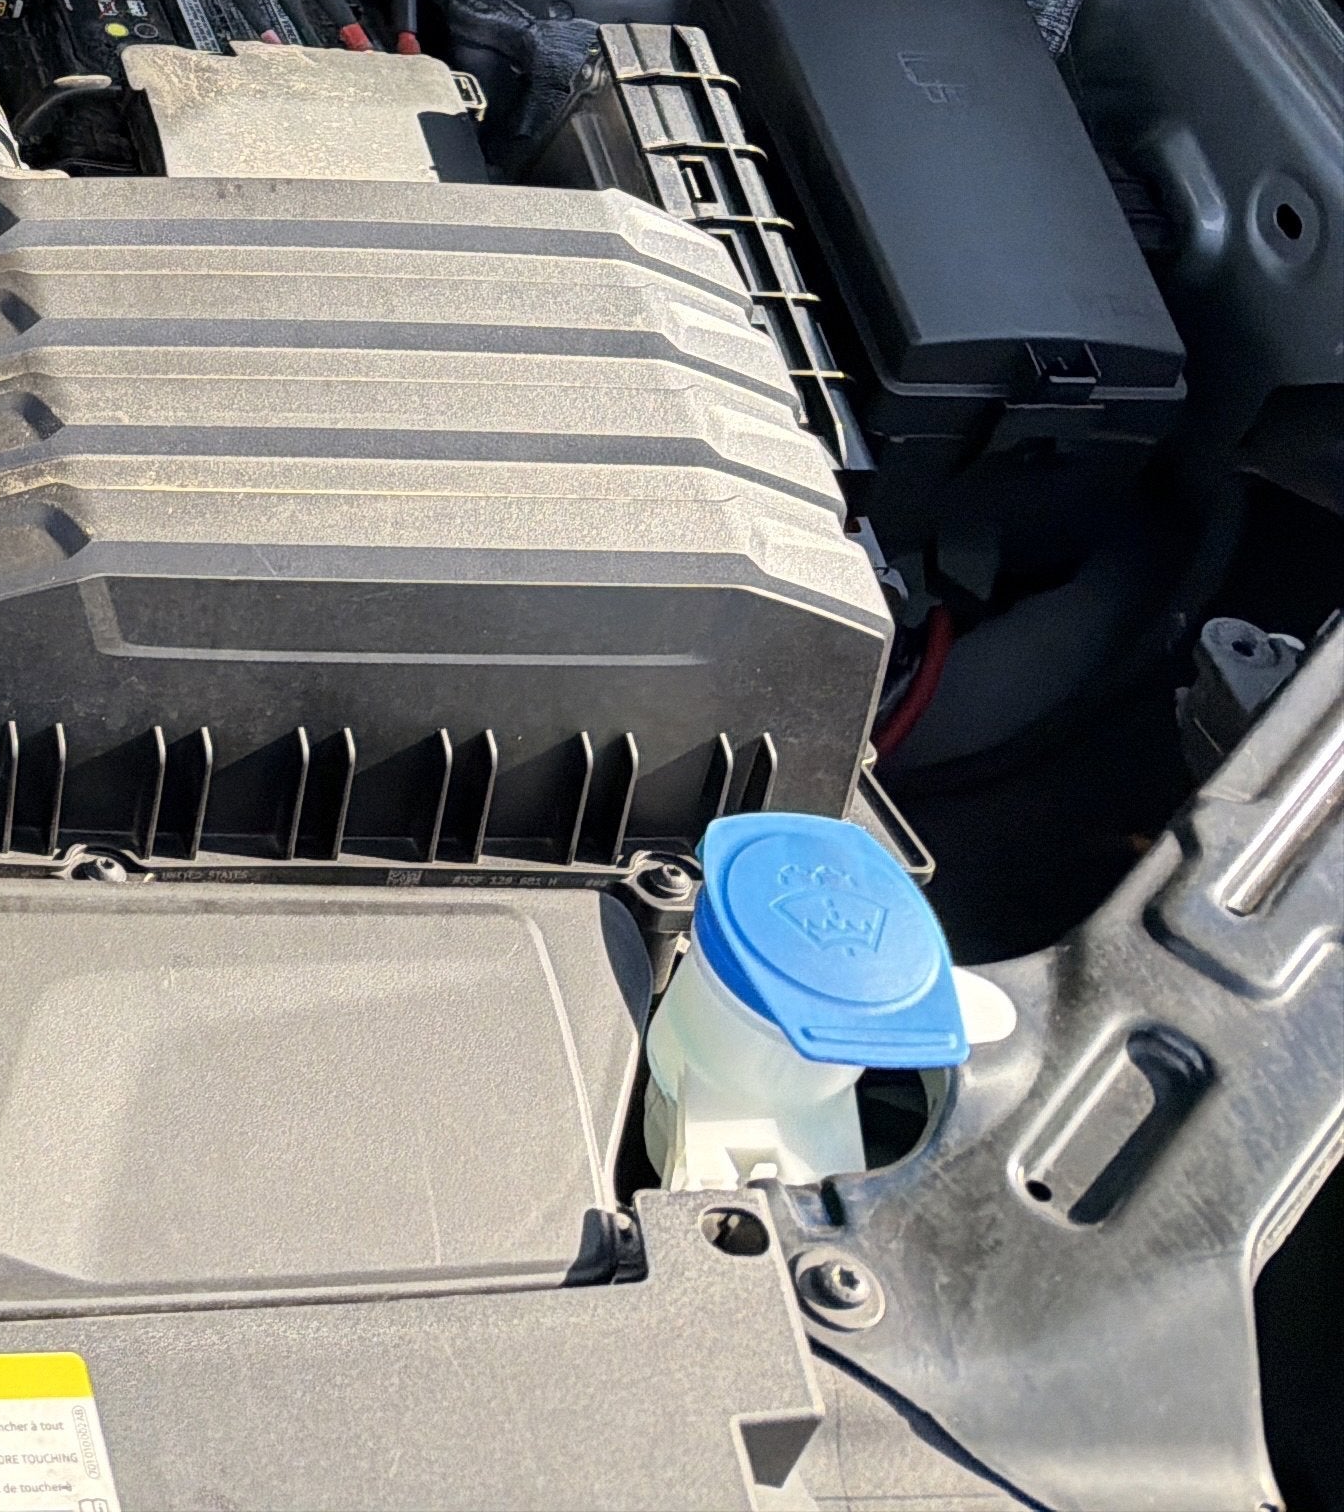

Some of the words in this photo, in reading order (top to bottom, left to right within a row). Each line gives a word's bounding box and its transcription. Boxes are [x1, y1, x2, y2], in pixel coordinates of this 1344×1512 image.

[30, 1421, 38, 1431] à
[40, 1421, 65, 1431] tout
[82, 1441, 94, 1458] 010
[21, 1453, 79, 1464] TOUCHING
[86, 1459, 98, 1475] 701
[3, 1483, 17, 1493] de
